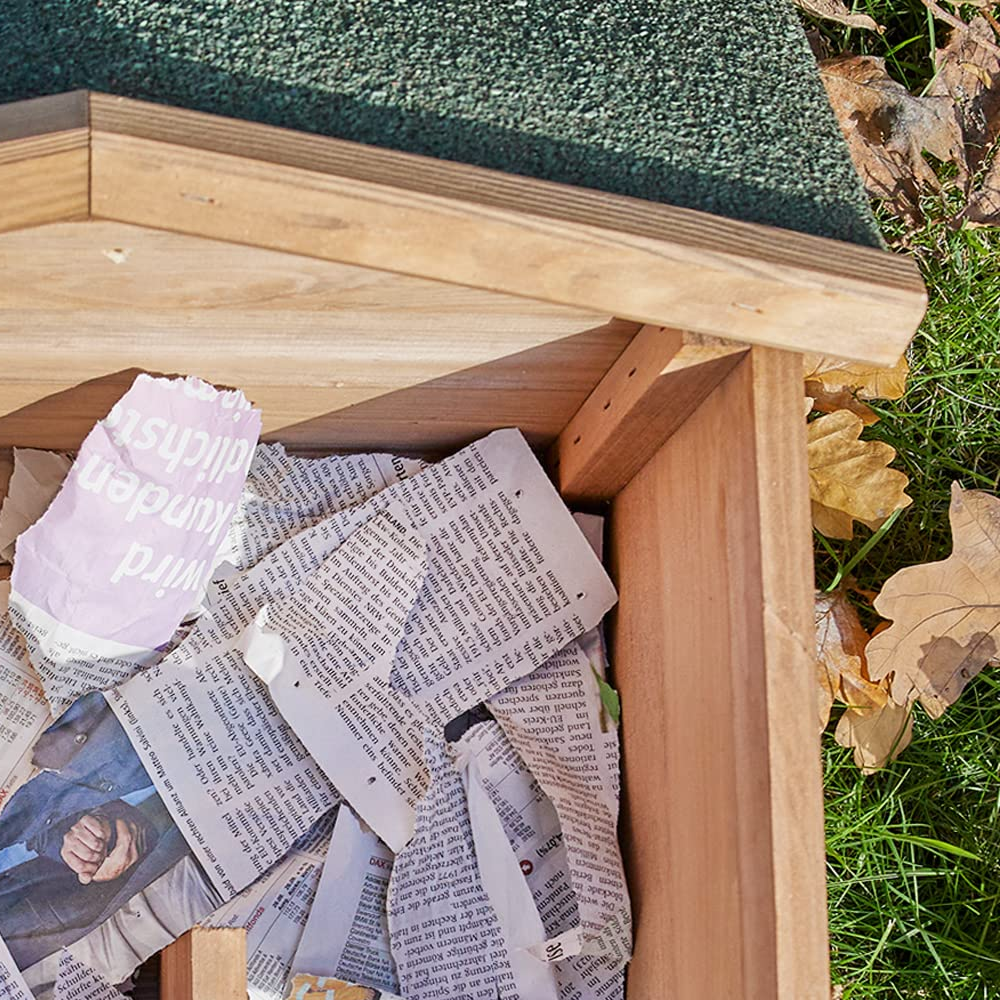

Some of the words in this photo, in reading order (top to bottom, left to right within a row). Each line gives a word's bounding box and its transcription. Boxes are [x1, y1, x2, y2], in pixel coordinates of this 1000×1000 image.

[109, 541, 207, 599] wird
[364, 602, 385, 621] NRW
[173, 679, 204, 730] Wahlkampf-
[133, 725, 152, 751] Salvini
[203, 732, 219, 753] reine
[149, 751, 166, 778] Matteo
[228, 755, 255, 790] parolen?
[163, 778, 174, 792] um
[171, 793, 188, 817] Allianz
[186, 818, 205, 845] rechten
[202, 846, 217, 863] einer
[214, 864, 226, 879] von
